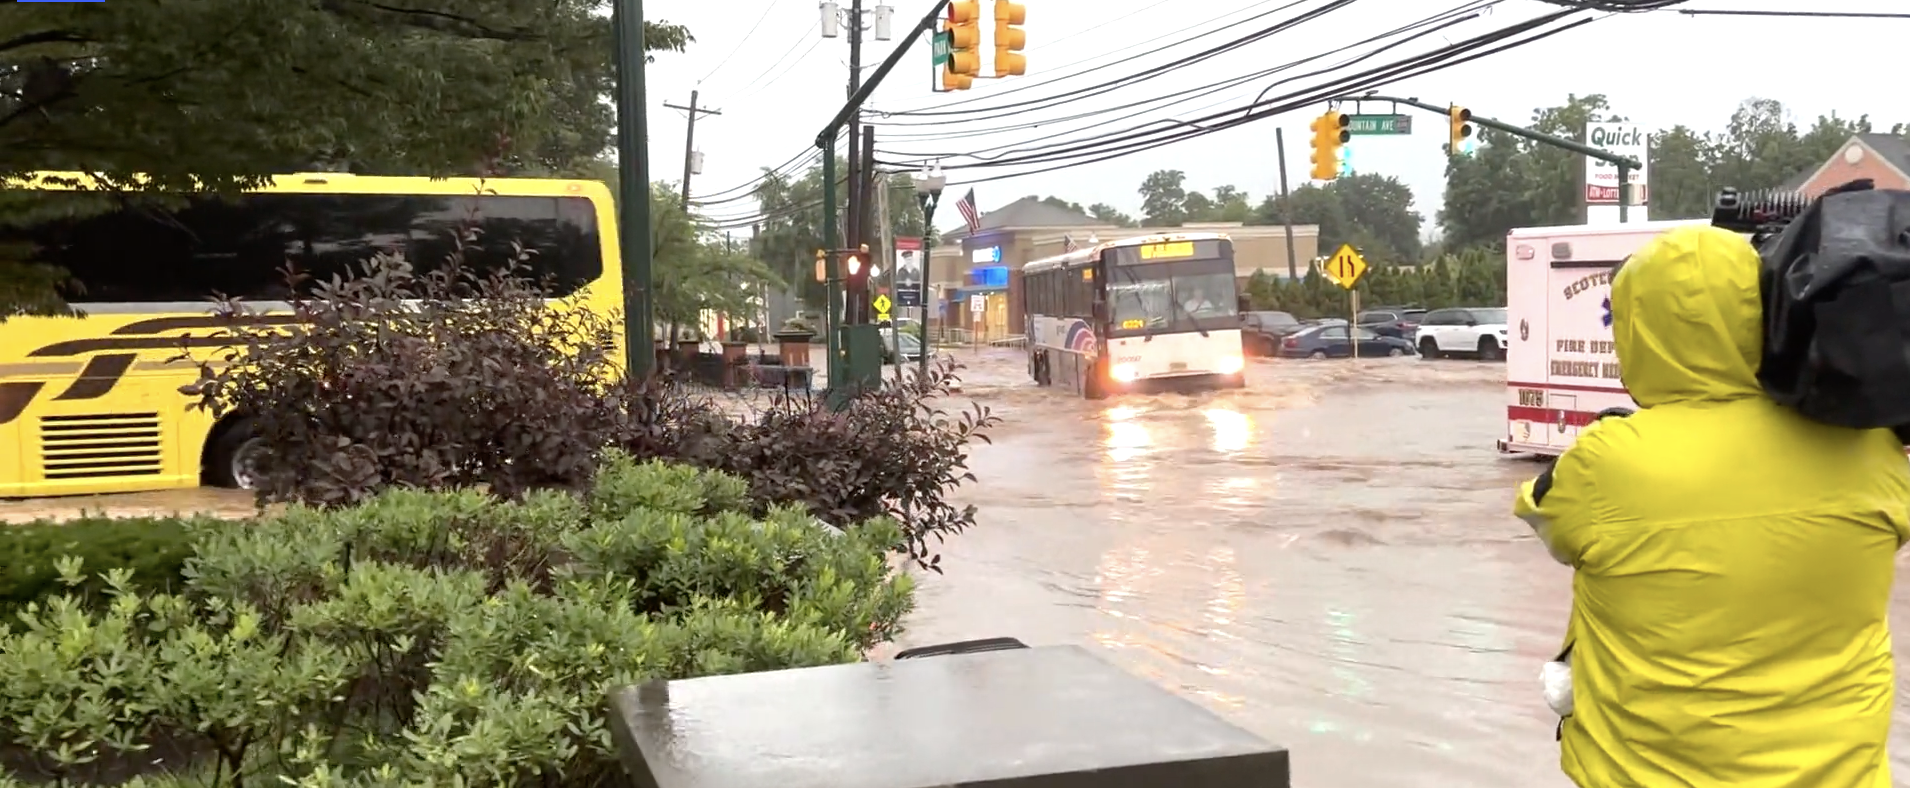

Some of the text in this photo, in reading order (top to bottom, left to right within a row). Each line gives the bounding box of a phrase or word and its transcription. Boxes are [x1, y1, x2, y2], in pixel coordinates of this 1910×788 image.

[1347, 120, 1377, 131] OUNTAIN
[1381, 120, 1394, 131] AVE
[1591, 126, 1642, 147] Quick
[1556, 339, 1616, 354] FIRE DEP
[1550, 360, 1599, 378] EMERGENCY
